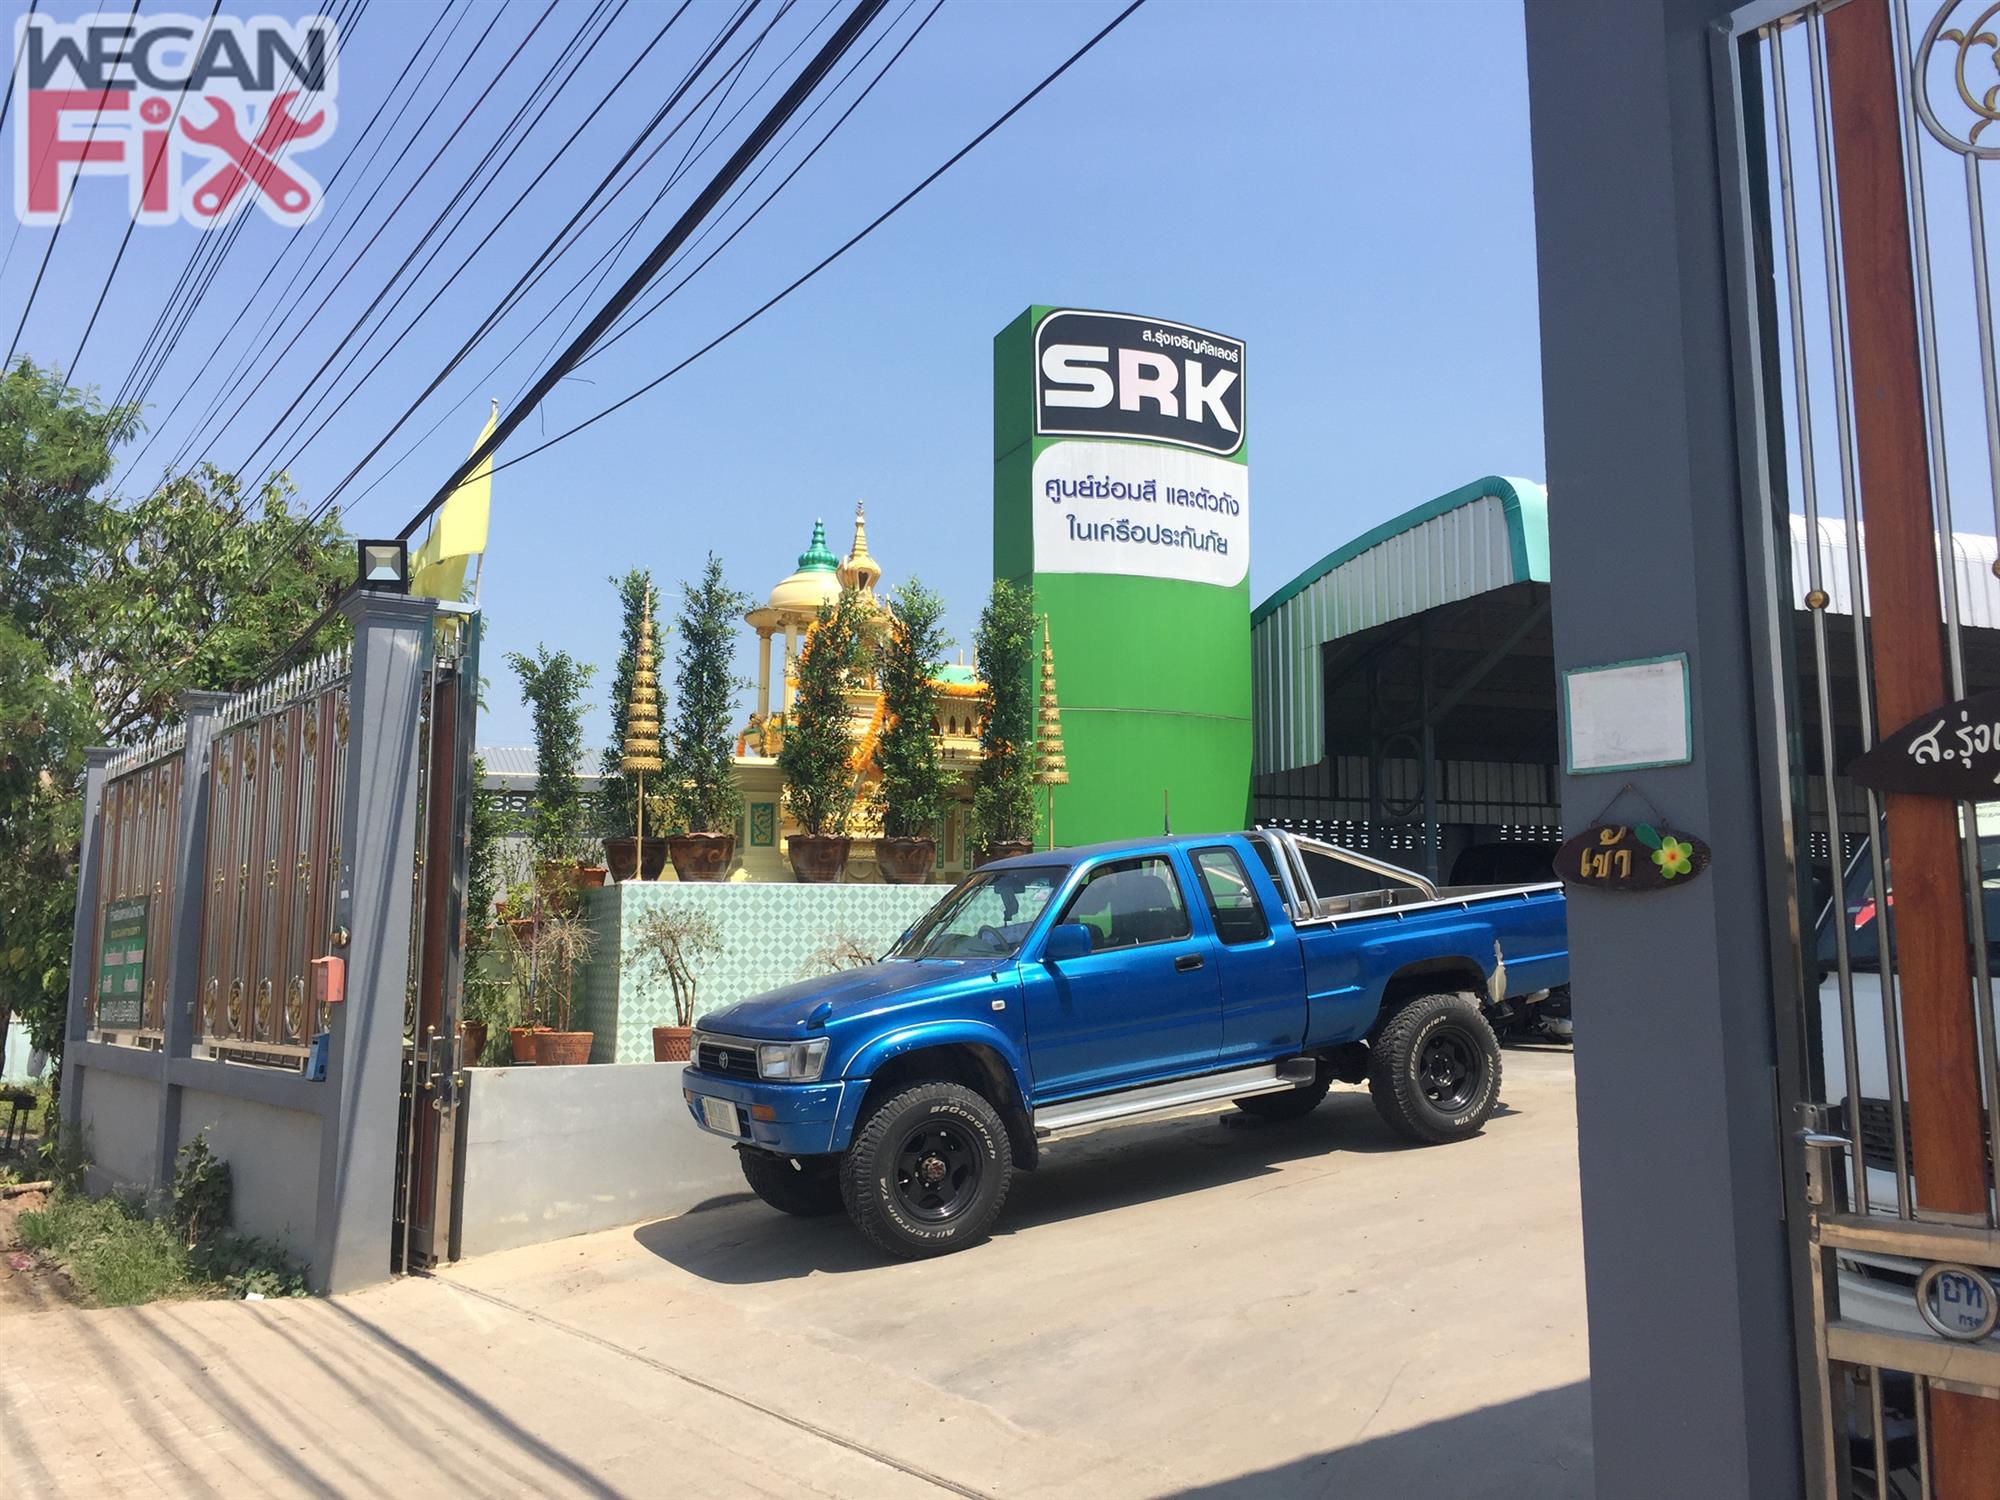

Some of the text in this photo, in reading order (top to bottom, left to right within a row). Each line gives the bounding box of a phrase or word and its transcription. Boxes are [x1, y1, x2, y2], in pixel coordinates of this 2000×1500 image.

[1041, 343, 1239, 434] SRK
[1045, 475, 1240, 517] ศูนย์ซ่อมสี และตัวถัง
[1066, 514, 1228, 555] ในเครือประกันภัย
[1580, 825, 1632, 879] เข้า
[929, 1105, 997, 1160] BFGoodrich
[887, 1204, 957, 1239] All-Terrain
